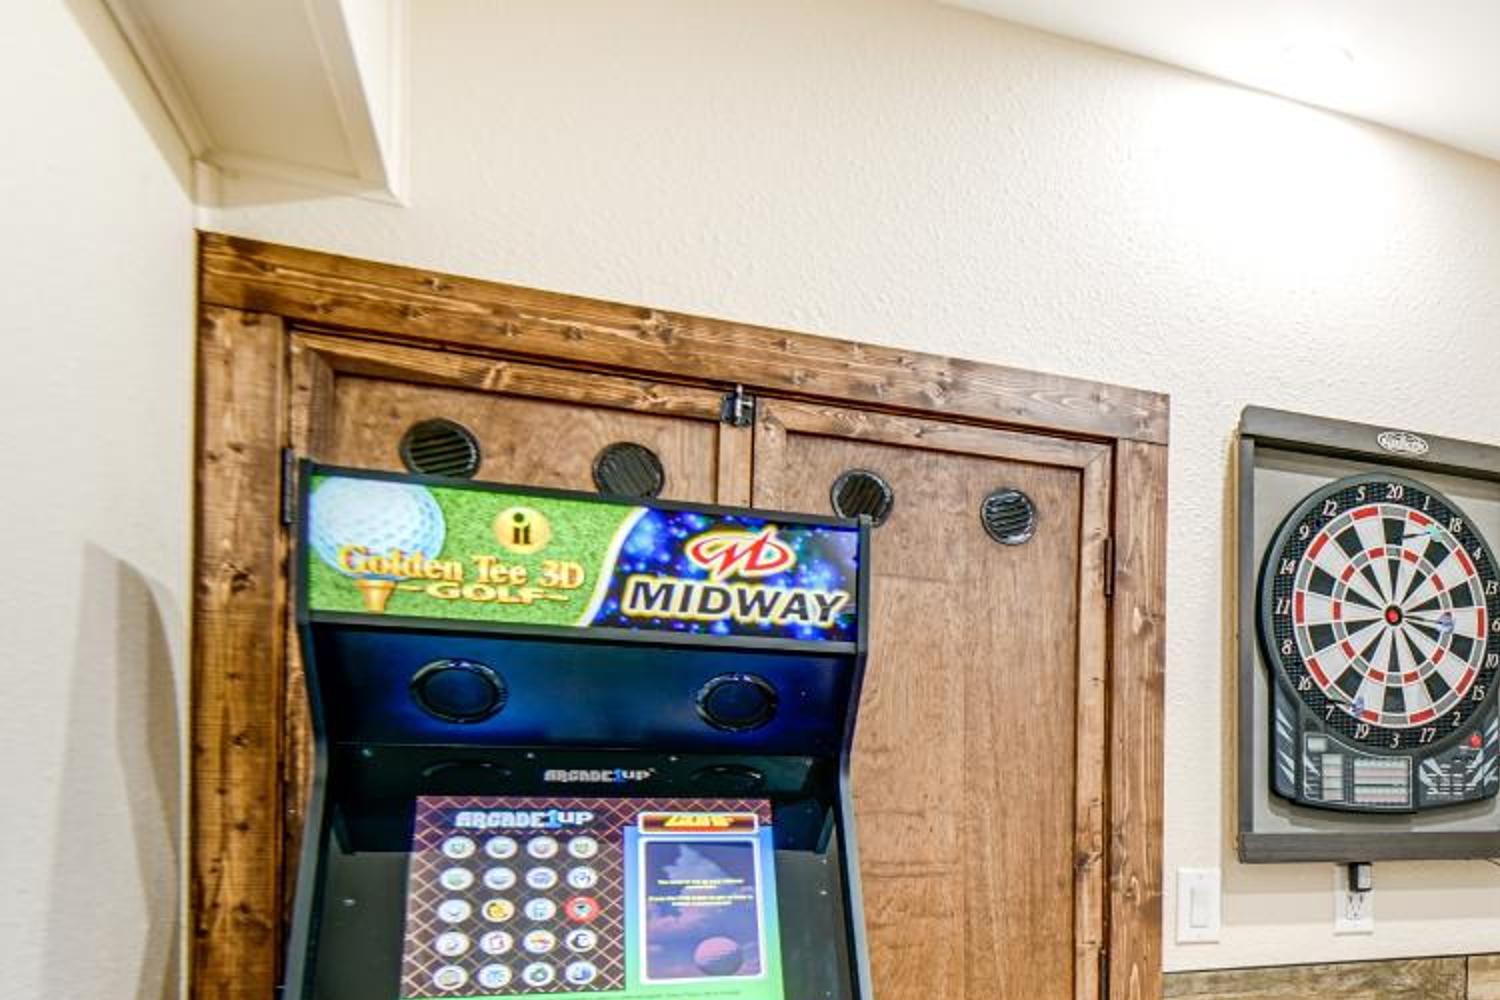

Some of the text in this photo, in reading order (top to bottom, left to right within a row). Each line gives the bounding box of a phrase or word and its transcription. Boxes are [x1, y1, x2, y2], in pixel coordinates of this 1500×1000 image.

[1356, 486, 1366, 501] 5
[1386, 484, 1404, 499] 20
[1322, 500, 1338, 516] 12
[1423, 496, 1430, 510] 1
[1299, 525, 1310, 540] 9
[1449, 517, 1462, 532] 18
[1472, 547, 1481, 560] 4
[339, 544, 585, 590] Golden Tee 3D
[1280, 558, 1296, 574] 14
[425, 582, 547, 604] GOLF
[1485, 580, 1499, 595] 13
[628, 579, 845, 623] MIDWAY
[1275, 598, 1290, 615] 11
[1281, 640, 1292, 655] 8
[1486, 653, 1499, 669] 10
[1298, 675, 1312, 691] 16
[1472, 685, 1485, 701] 15
[1325, 705, 1335, 721] 7
[1451, 711, 1461, 727] 2
[1353, 724, 1370, 739] 19
[1420, 727, 1436, 743] 17
[1390, 733, 1400, 748] 3
